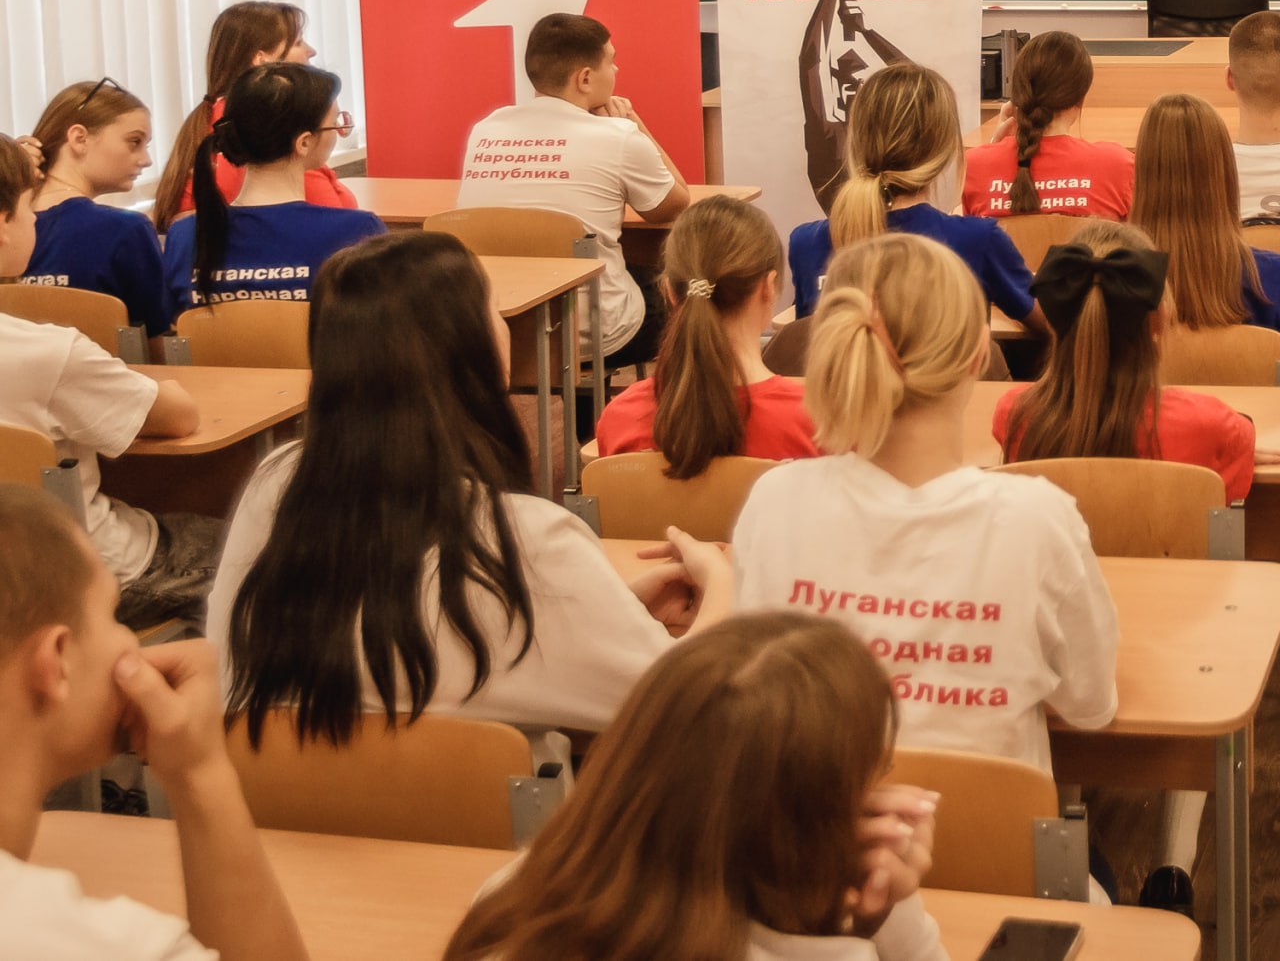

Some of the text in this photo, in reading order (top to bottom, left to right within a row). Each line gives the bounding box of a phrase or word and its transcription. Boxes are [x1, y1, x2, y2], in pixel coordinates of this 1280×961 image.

[476, 138, 567, 149] Луганская
[473, 153, 562, 164] Народная
[989, 179, 1091, 194] Лунская
[990, 197, 1088, 210] Надная
[788, 579, 1002, 621] Луганская
[869, 637, 993, 664] одная
[892, 672, 1009, 707] блика
